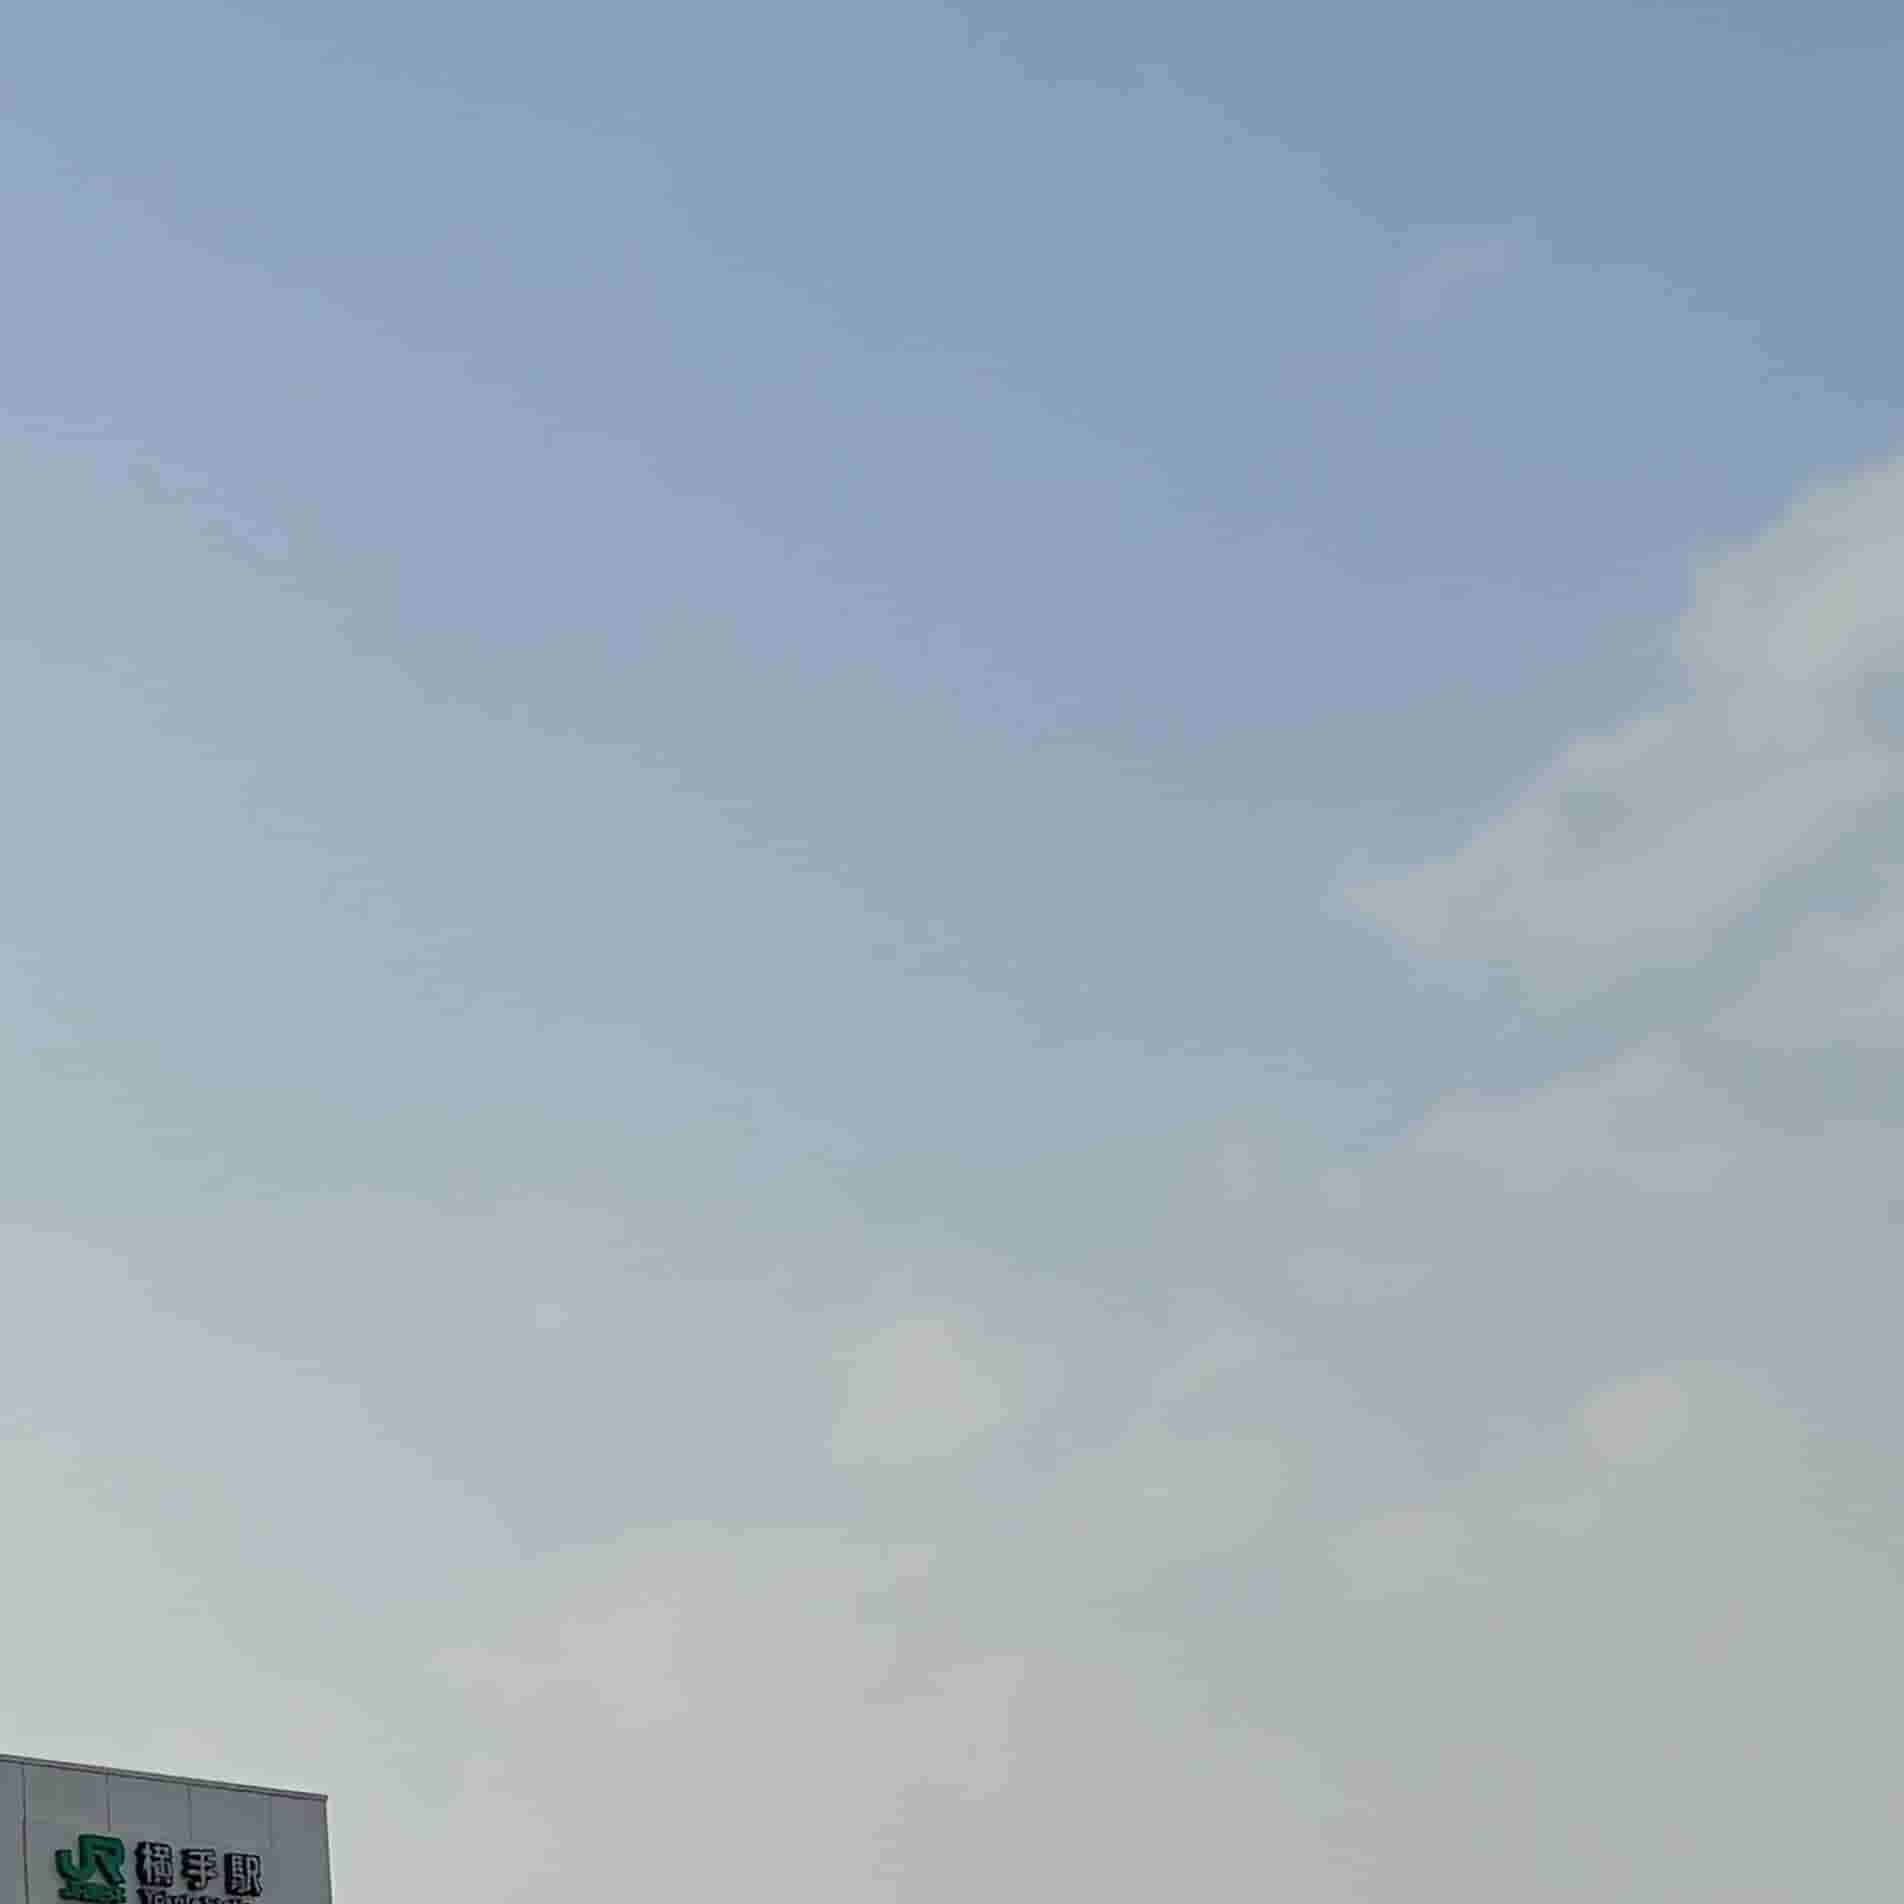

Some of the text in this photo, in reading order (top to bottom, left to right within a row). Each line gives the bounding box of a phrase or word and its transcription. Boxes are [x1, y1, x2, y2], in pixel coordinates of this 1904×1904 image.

[55, 1834, 127, 1887] JR
[135, 1840, 264, 1897] 横手駅
